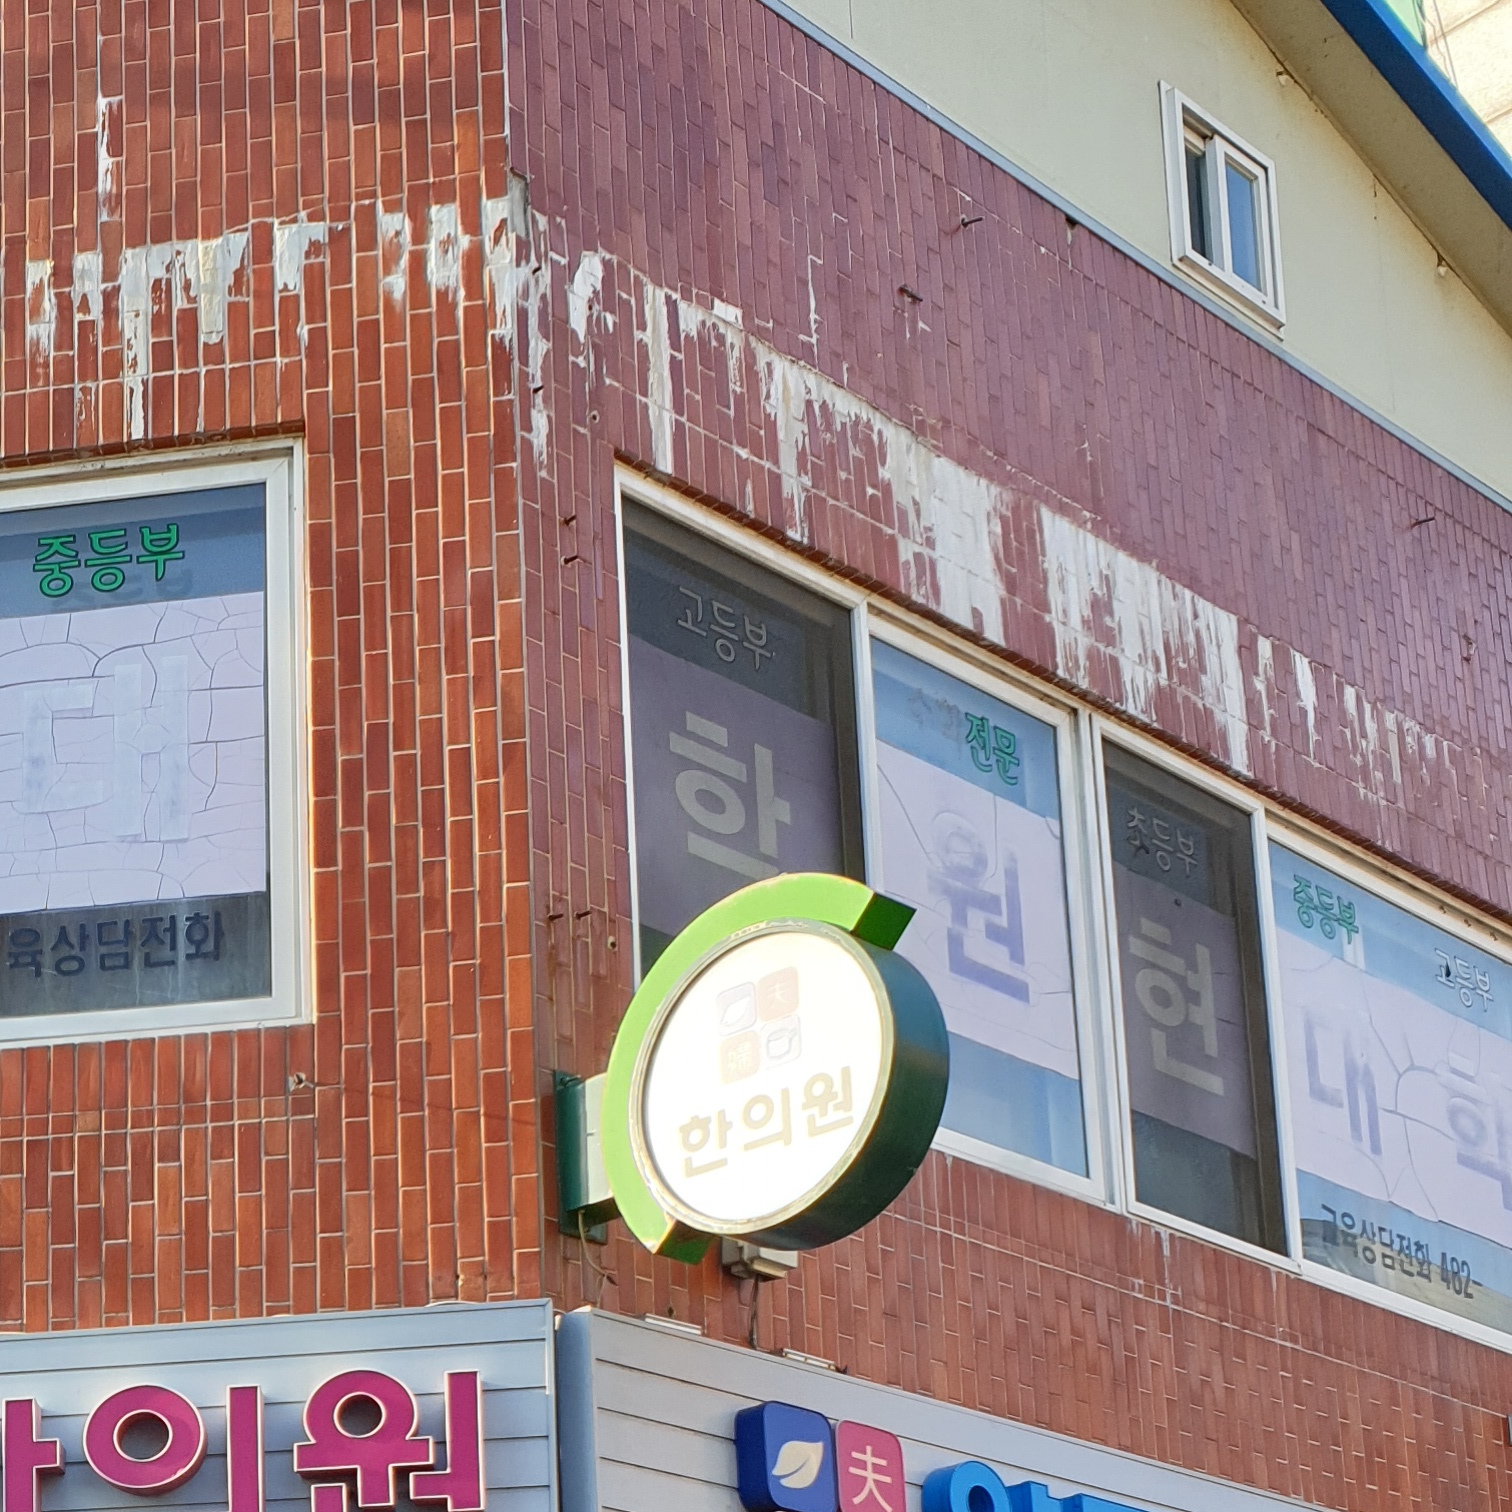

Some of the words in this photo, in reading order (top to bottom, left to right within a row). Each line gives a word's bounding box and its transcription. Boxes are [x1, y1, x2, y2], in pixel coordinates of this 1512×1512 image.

[32, 523, 185, 597] 중등부
[676, 585, 776, 671] 고등부
[964, 711, 1021, 787] 전문
[926, 808, 1031, 1005] 원
[1125, 806, 1199, 876] 초등부
[1292, 873, 1359, 945] 중등부
[1434, 947, 1496, 1013] 고등부
[1129, 918, 1225, 1097] 현
[677, 1065, 855, 1179] 한의원
